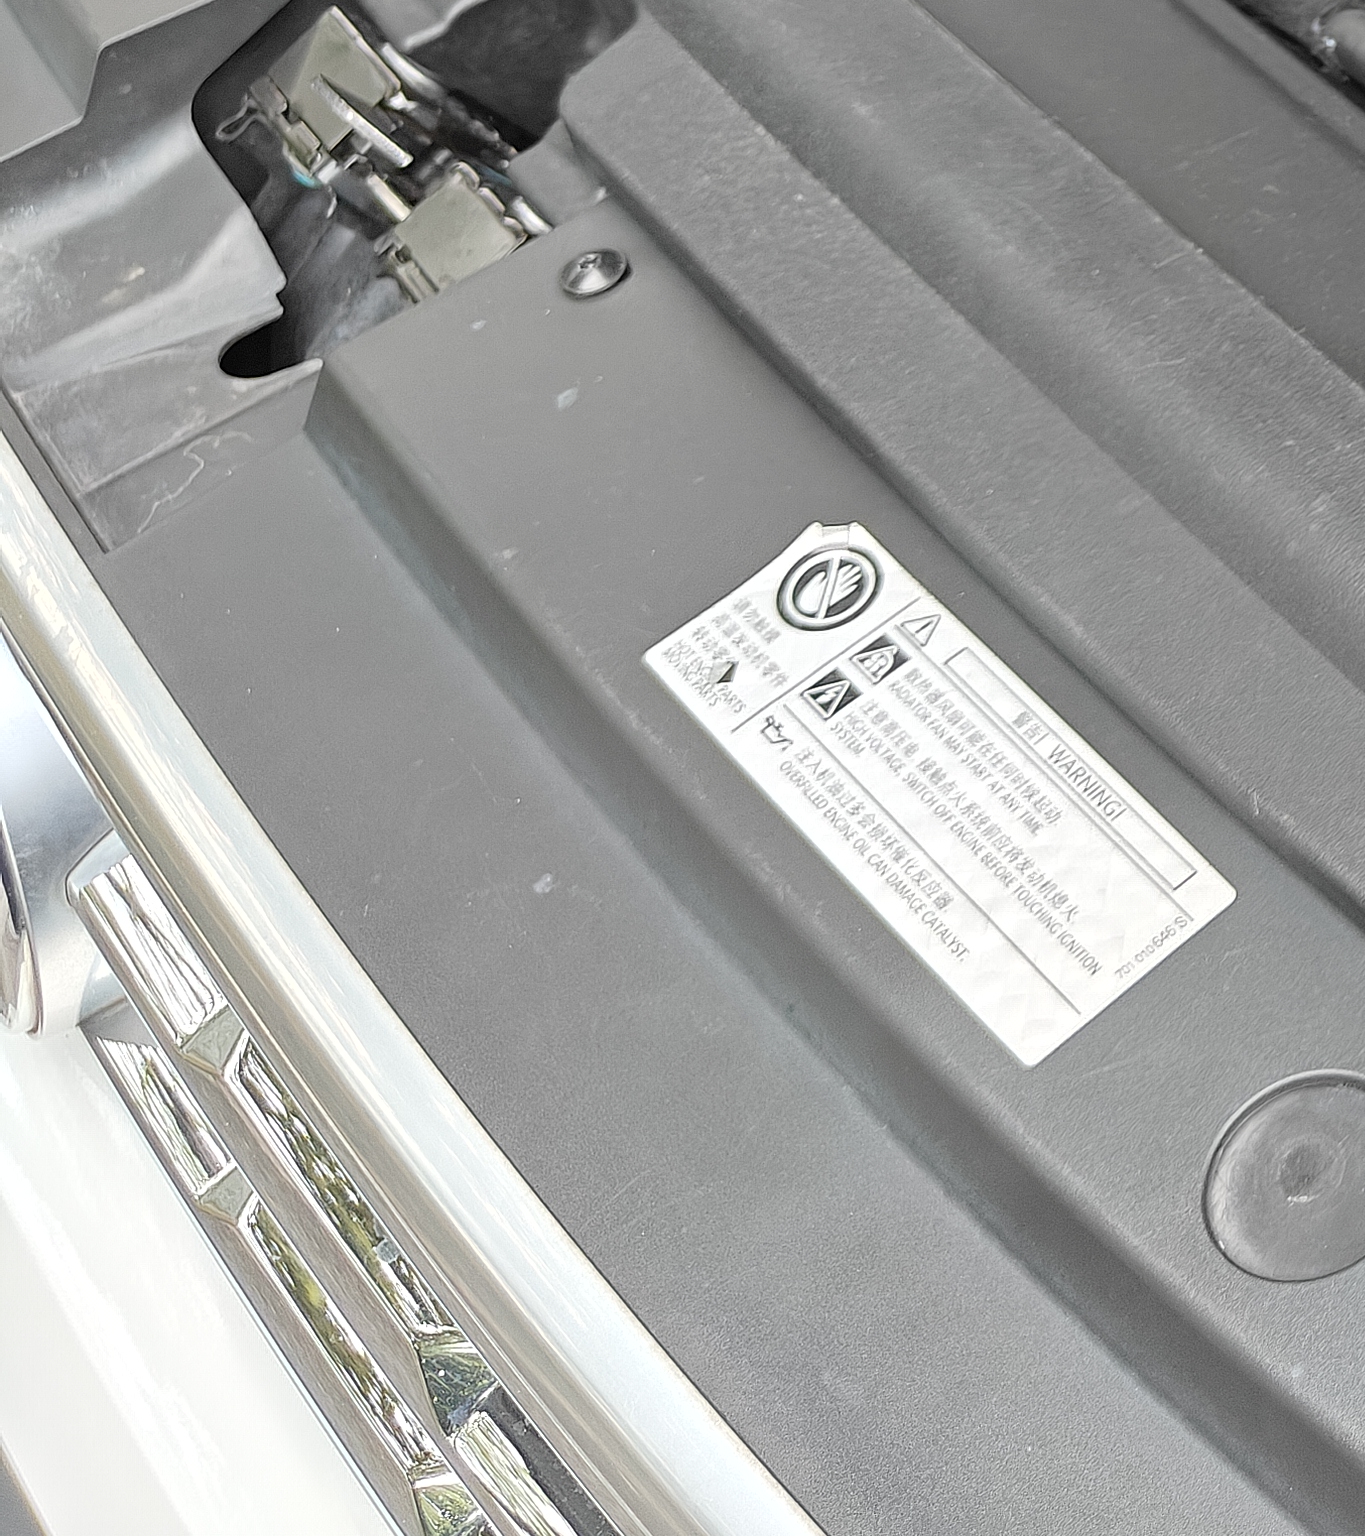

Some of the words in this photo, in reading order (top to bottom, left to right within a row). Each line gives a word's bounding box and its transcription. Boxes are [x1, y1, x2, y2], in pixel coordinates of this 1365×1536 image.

[885, 677, 934, 723] RADIATOR
[924, 716, 951, 741] FAN
[940, 732, 969, 758] MAY
[959, 751, 994, 783] START
[985, 776, 1008, 796] AT
[997, 788, 1026, 815] ANY
[777, 758, 830, 812] OVERFILLED
[821, 805, 860, 843] ENGINE
[850, 835, 874, 858] OIL
[864, 851, 892, 877] CAN
[883, 871, 928, 916] DAMAGE
[841, 710, 871, 737] HIGH
[901, 770, 941, 808] SWITCH
[931, 801, 957, 826] OFF
[948, 819, 988, 857] ENGINE
[978, 850, 1019, 889] BEFORE
[1009, 882, 1064, 935] TOUCHING
[1055, 929, 1103, 976] IGNITION
[1114, 961, 1136, 979] 701
[1134, 944, 1155, 963] 010
[1151, 925, 1177, 948] 646
[1174, 916, 1188, 928] S
